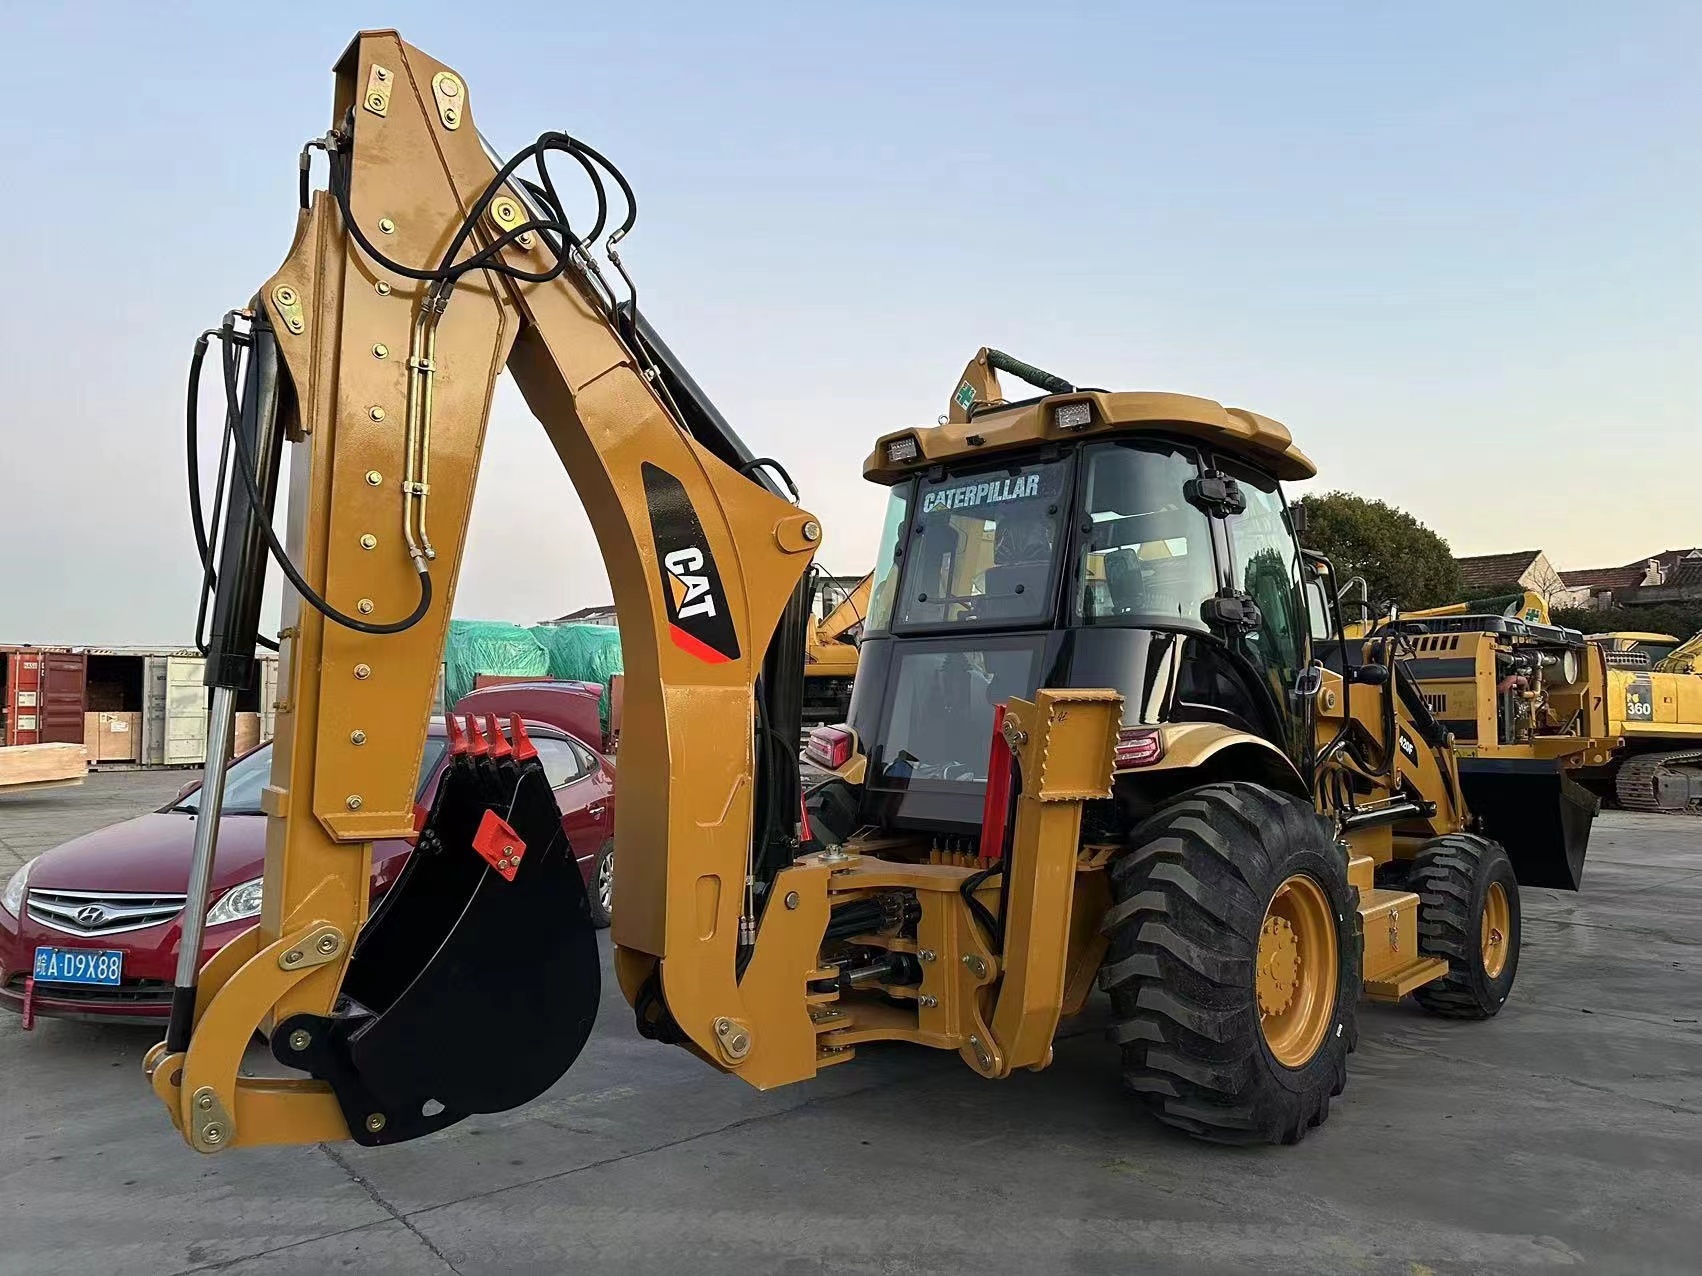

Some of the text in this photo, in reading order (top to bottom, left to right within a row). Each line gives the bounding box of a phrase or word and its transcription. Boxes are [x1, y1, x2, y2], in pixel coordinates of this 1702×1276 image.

[923, 475, 1039, 513] CATERPILLAR
[665, 547, 717, 619] CAT
[1627, 702, 1651, 715] 360
